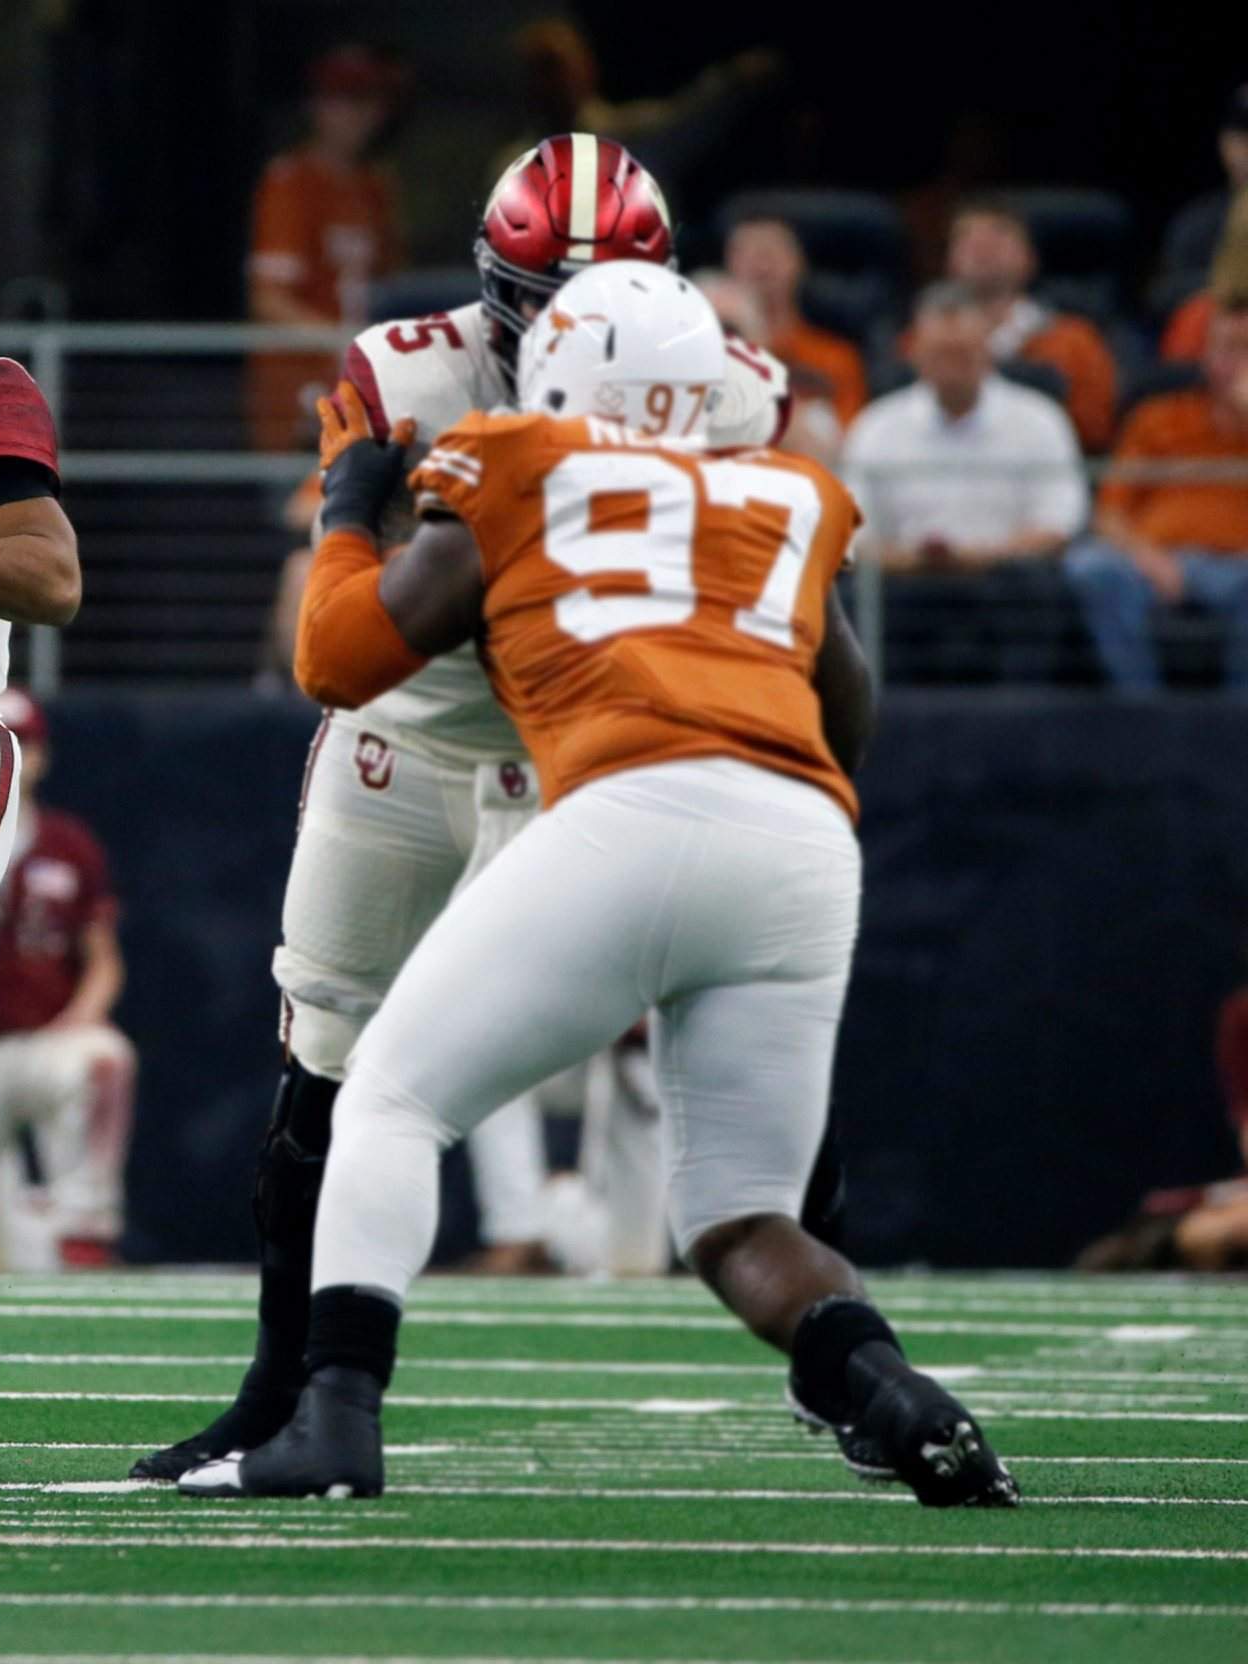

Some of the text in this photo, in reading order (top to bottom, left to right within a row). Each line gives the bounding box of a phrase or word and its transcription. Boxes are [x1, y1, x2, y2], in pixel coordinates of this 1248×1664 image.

[385, 311, 465, 354] 5
[639, 383, 708, 438] 97
[544, 451, 824, 652] 97
